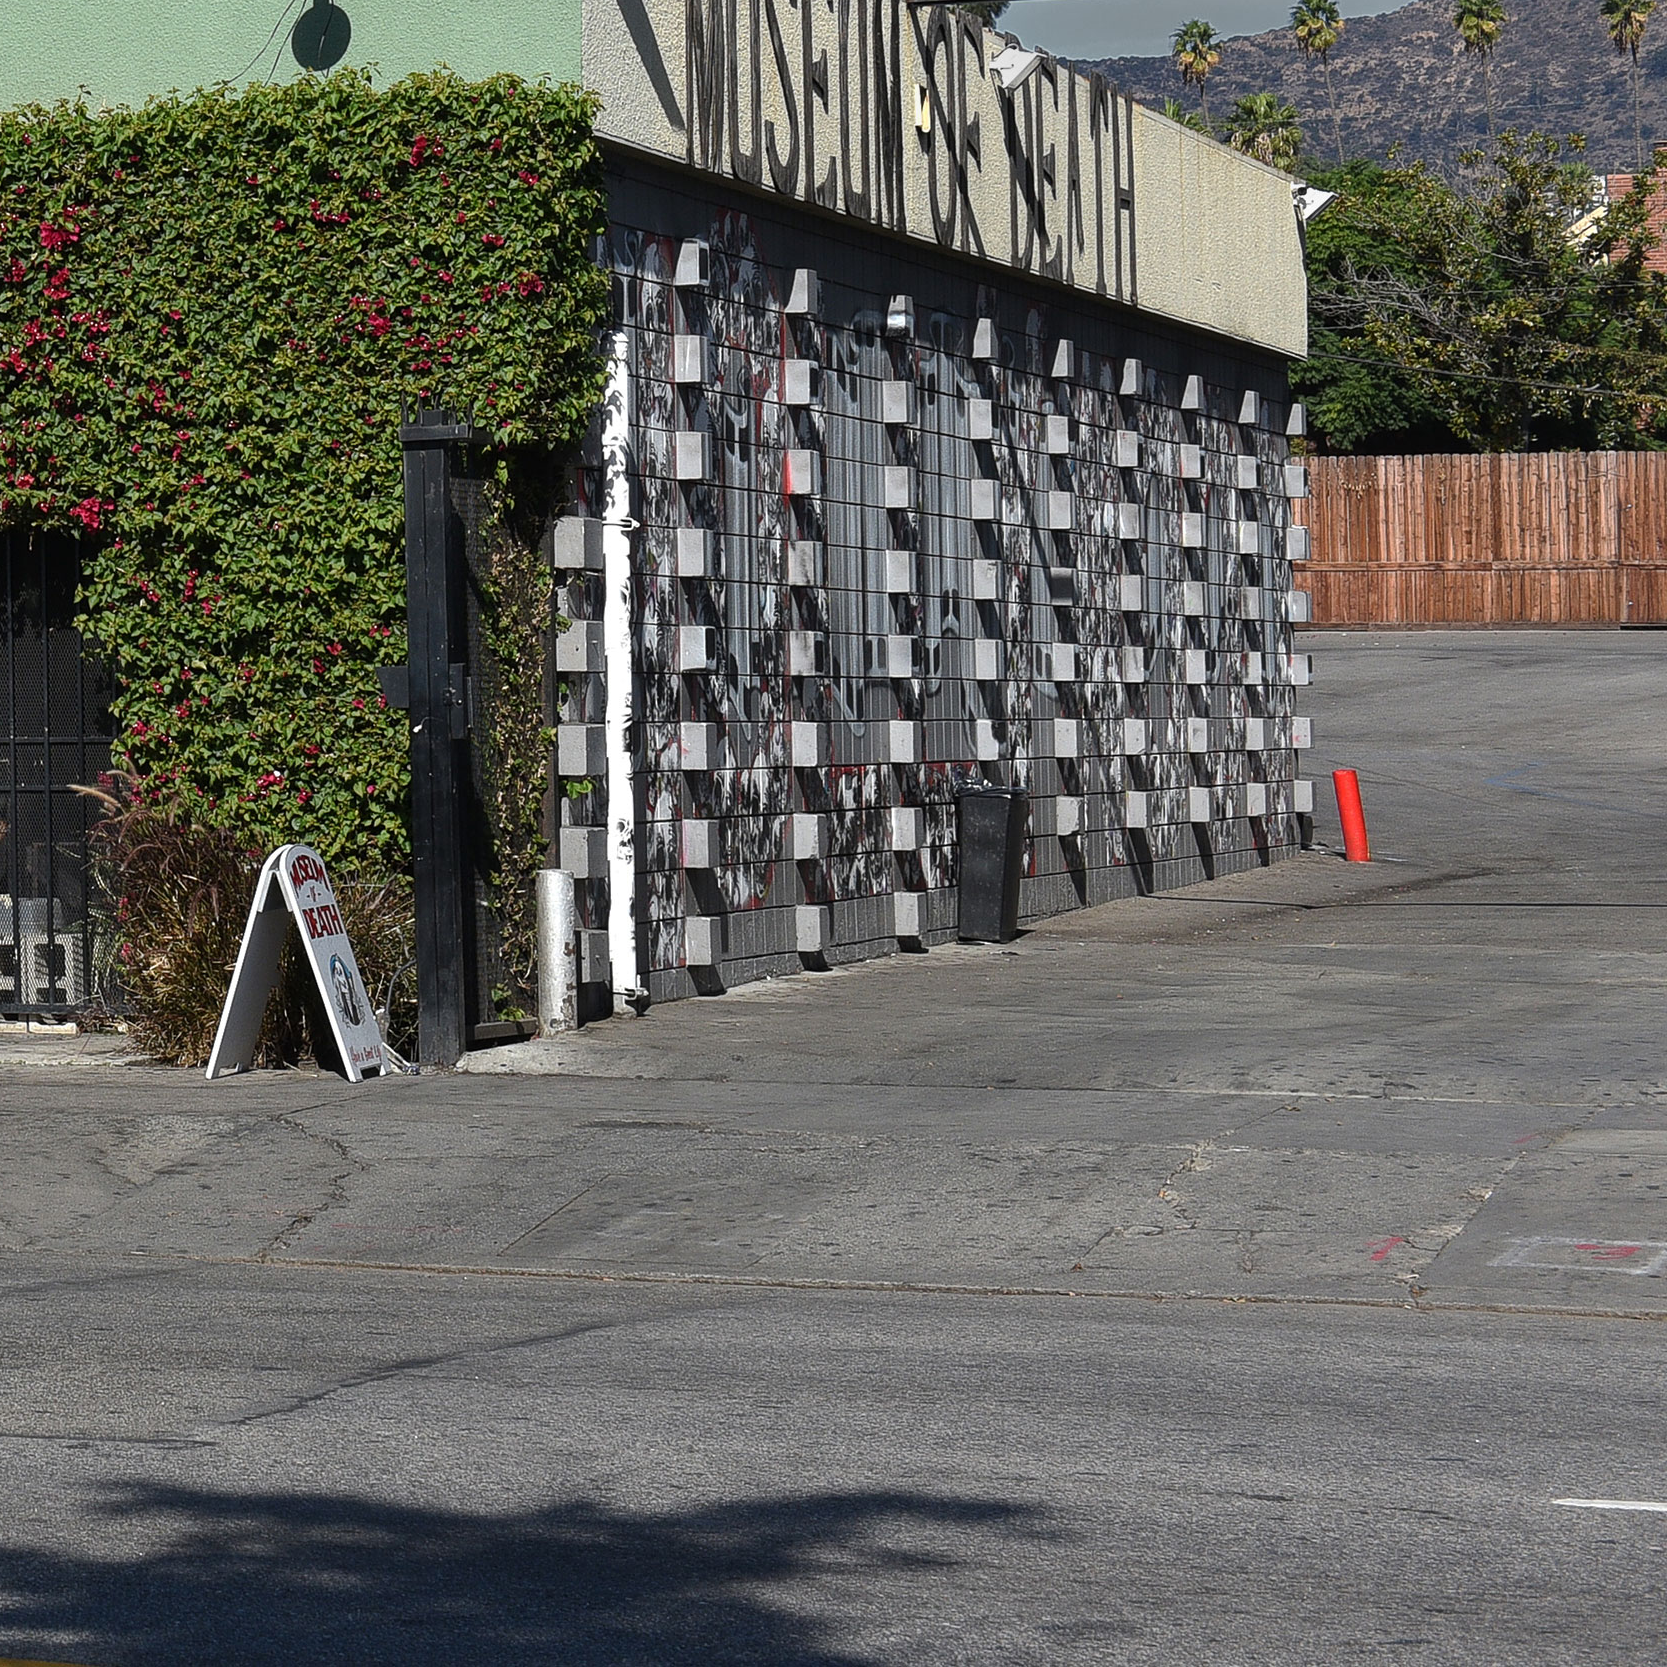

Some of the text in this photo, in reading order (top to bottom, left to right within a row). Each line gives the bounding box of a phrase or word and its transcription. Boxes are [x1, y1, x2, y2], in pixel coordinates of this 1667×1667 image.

[927, 2, 987, 253] OF
[289, 854, 331, 900] MUSEUM
[301, 904, 344, 940] DEATH
